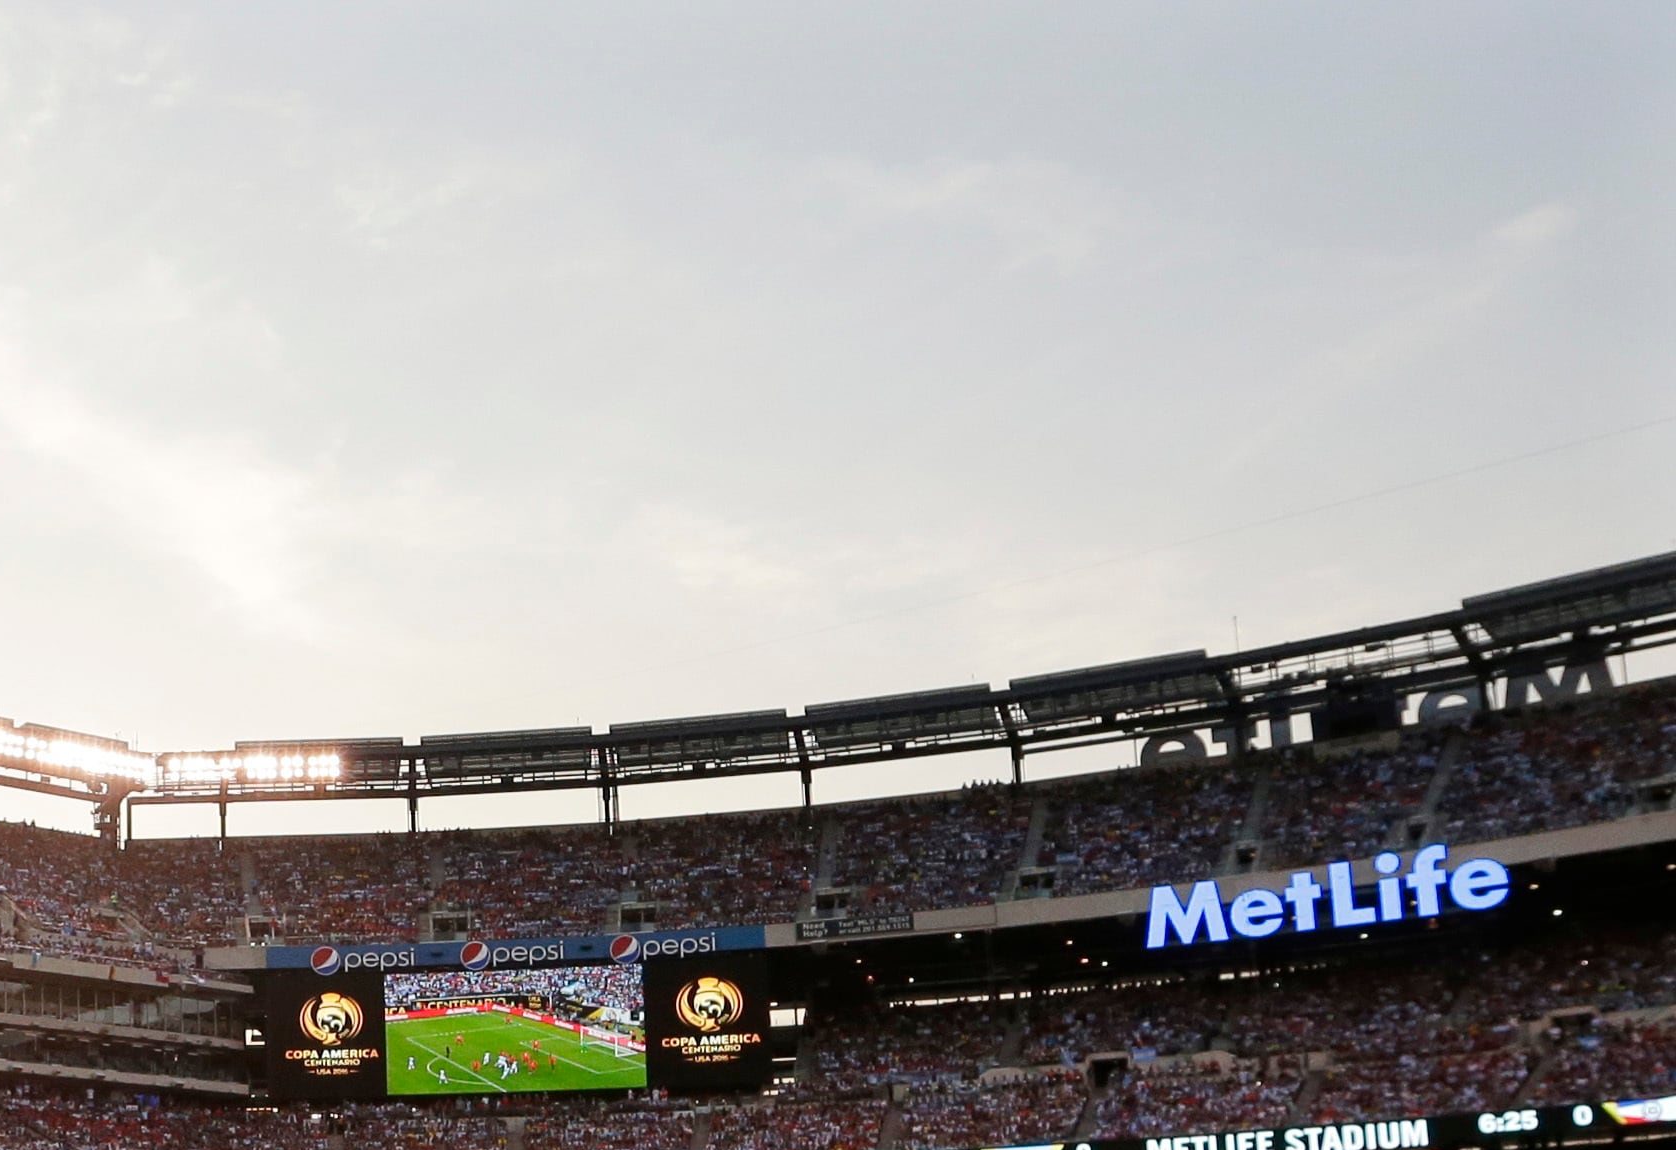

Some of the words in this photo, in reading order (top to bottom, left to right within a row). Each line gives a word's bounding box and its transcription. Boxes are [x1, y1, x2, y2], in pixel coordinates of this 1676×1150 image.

[1146, 843, 1511, 949] MetLife
[803, 922, 825, 930] Need
[803, 929, 829, 938] Help?
[492, 940, 564, 966] pepsi
[643, 932, 716, 960] pepsi
[344, 947, 415, 973] pepsi
[662, 1037, 697, 1047] COPA
[700, 1033, 761, 1046] AMERICA
[285, 1049, 319, 1059] COPA
[321, 1049, 379, 1059] AMERICA
[681, 1044, 741, 1054] CENTENARIO
[304, 1059, 360, 1067] CENTENARIO
[1477, 1109, 1539, 1134] 6:25
[1572, 1105, 1593, 1126] 0
